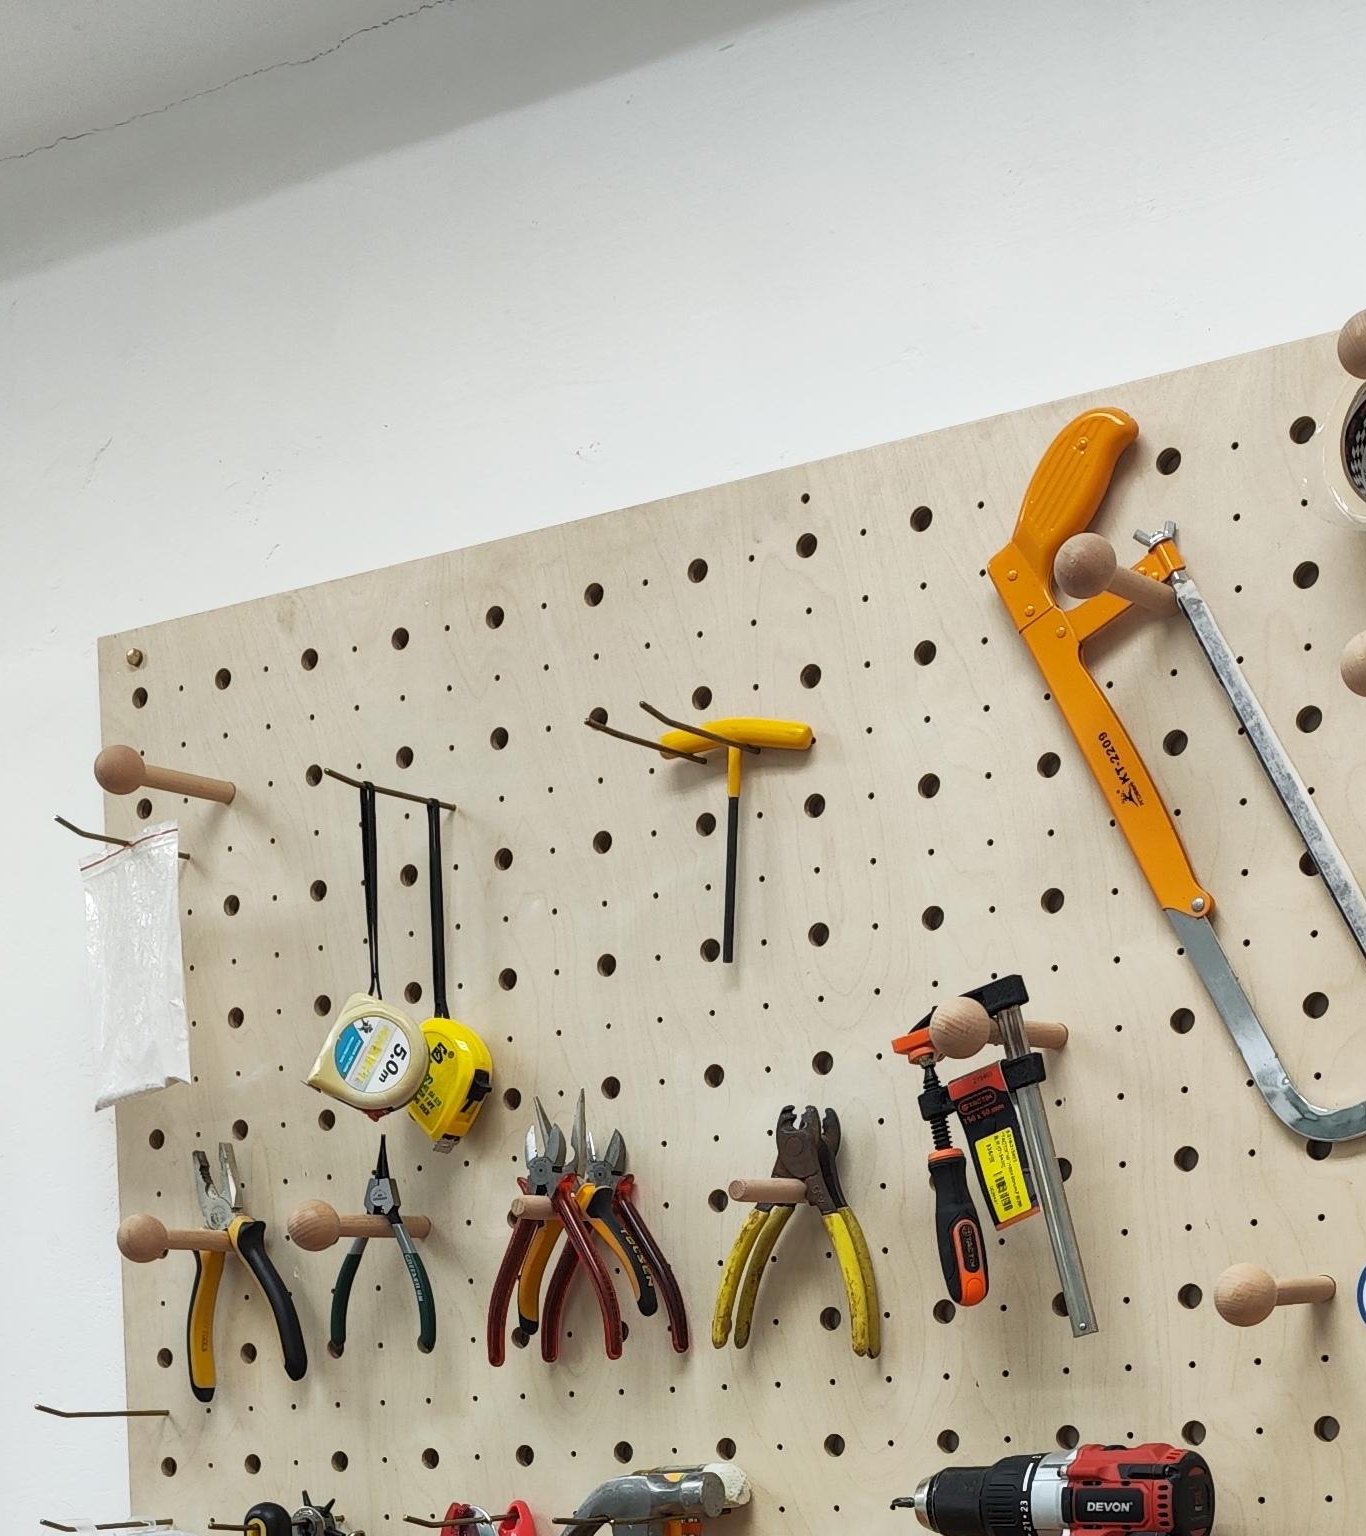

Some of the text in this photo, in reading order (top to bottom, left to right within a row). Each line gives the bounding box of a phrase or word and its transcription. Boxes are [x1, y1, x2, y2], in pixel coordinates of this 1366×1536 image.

[1098, 731, 1130, 785] KT-2209
[378, 1042, 408, 1084] 5.0m
[620, 1228, 653, 1287] TOLSEN
[1020, 1500, 1029, 1513] 23
[1087, 1501, 1131, 1513] DEVON
